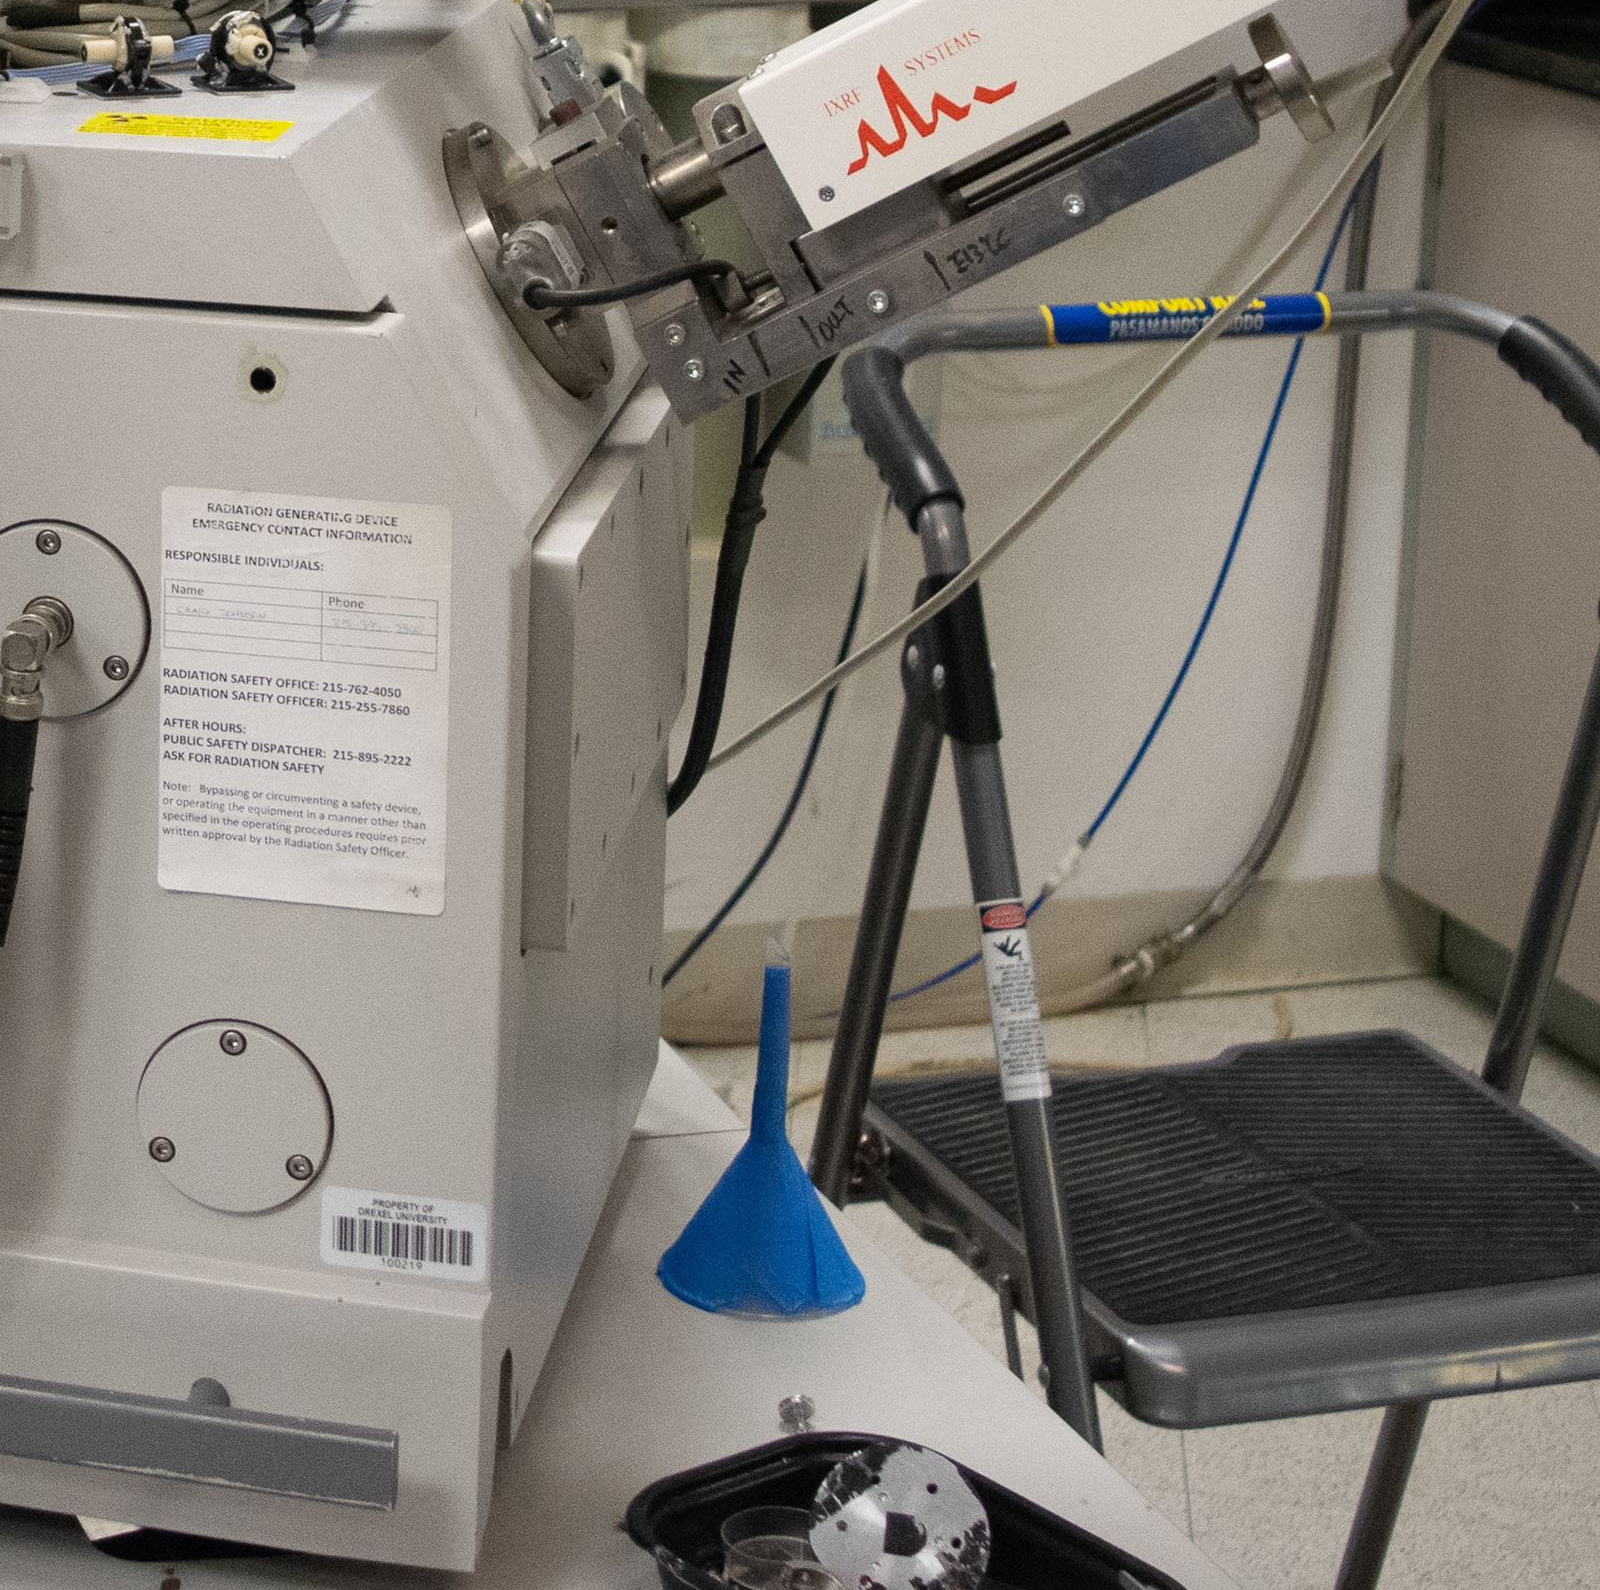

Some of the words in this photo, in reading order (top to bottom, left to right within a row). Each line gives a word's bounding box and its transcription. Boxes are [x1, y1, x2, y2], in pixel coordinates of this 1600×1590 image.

[824, 89, 863, 117] IXRF
[904, 28, 982, 76] SYSTEMS
[818, 295, 855, 343] OUT
[1110, 317, 1204, 338] PASAMANOS
[722, 359, 746, 396] IN
[207, 502, 272, 517] RADIATION
[276, 508, 352, 524] GENERATING
[355, 513, 398, 527] DEVICE
[192, 518, 264, 533] EMERGENCY
[267, 524, 322, 539] CONTACT
[325, 529, 413, 545] INFORMATION
[165, 549, 241, 566] RESPONSIBLE
[245, 556, 324, 572] INDIVIDUALS:
[171, 583, 204, 597] Name
[328, 596, 365, 609] Phone
[163, 667, 227, 683] RADIATION
[230, 674, 272, 688] SAFETY
[276, 678, 319, 691] OFFICE:
[322, 682, 402, 699] 215-762-4050
[163, 684, 228, 700] RADIATION
[231, 690, 274, 705] SAFETY
[276, 695, 328, 709] OFFICER:
[331, 699, 410, 716] 215-255-7860
[163, 717, 199, 731] AFTER
[202, 721, 247, 734] HOURS:
[163, 734, 203, 747] PUBLIC
[206, 738, 248, 752] SAFETY
[251, 742, 327, 759] DISPATCHER:
[333, 749, 412, 767] 215-895-2222
[163, 750, 185, 762] ASK
[188, 753, 211, 764] FOR
[214, 755, 279, 771] RADIATION
[282, 761, 325, 775] SAFETY
[162, 797, 174, 806] or
[176, 798, 225, 813] operating
[228, 802, 245, 813] the
[248, 804, 303, 820] equipment
[306, 809, 316, 819] in
[319, 813, 325, 821] a
[328, 813, 368, 825] manner
[370, 816, 399, 828] other
[402, 819, 426, 831] than
[163, 780, 191, 793] Note:
[199, 784, 250, 800] Bypassing
[252, 790, 263, 799] or
[266, 791, 339, 809] circumventing
[342, 799, 348, 807] a
[351, 798, 382, 813] safety
[385, 802, 421, 816] device,
[162, 810, 208, 826] specified
[210, 815, 220, 825] in
[222, 816, 240, 827] the
[242, 818, 292, 834] operating
[294, 823, 353, 839] procedures
[355, 830, 399, 845] requires
[162, 826, 200, 839] written
[202, 829, 247, 844] approval
[249, 833, 262, 846] by
[264, 835, 281, 847] the
[284, 838, 333, 852] Radiation
[335, 841, 368, 857] Safety
[370, 845, 410, 859] Officer.
[358, 1207, 393, 1220] DREXEL
[395, 1212, 449, 1226] UNIVERSITY
[372, 1198, 420, 1212] PROPERTY
[422, 1204, 434, 1213] OF
